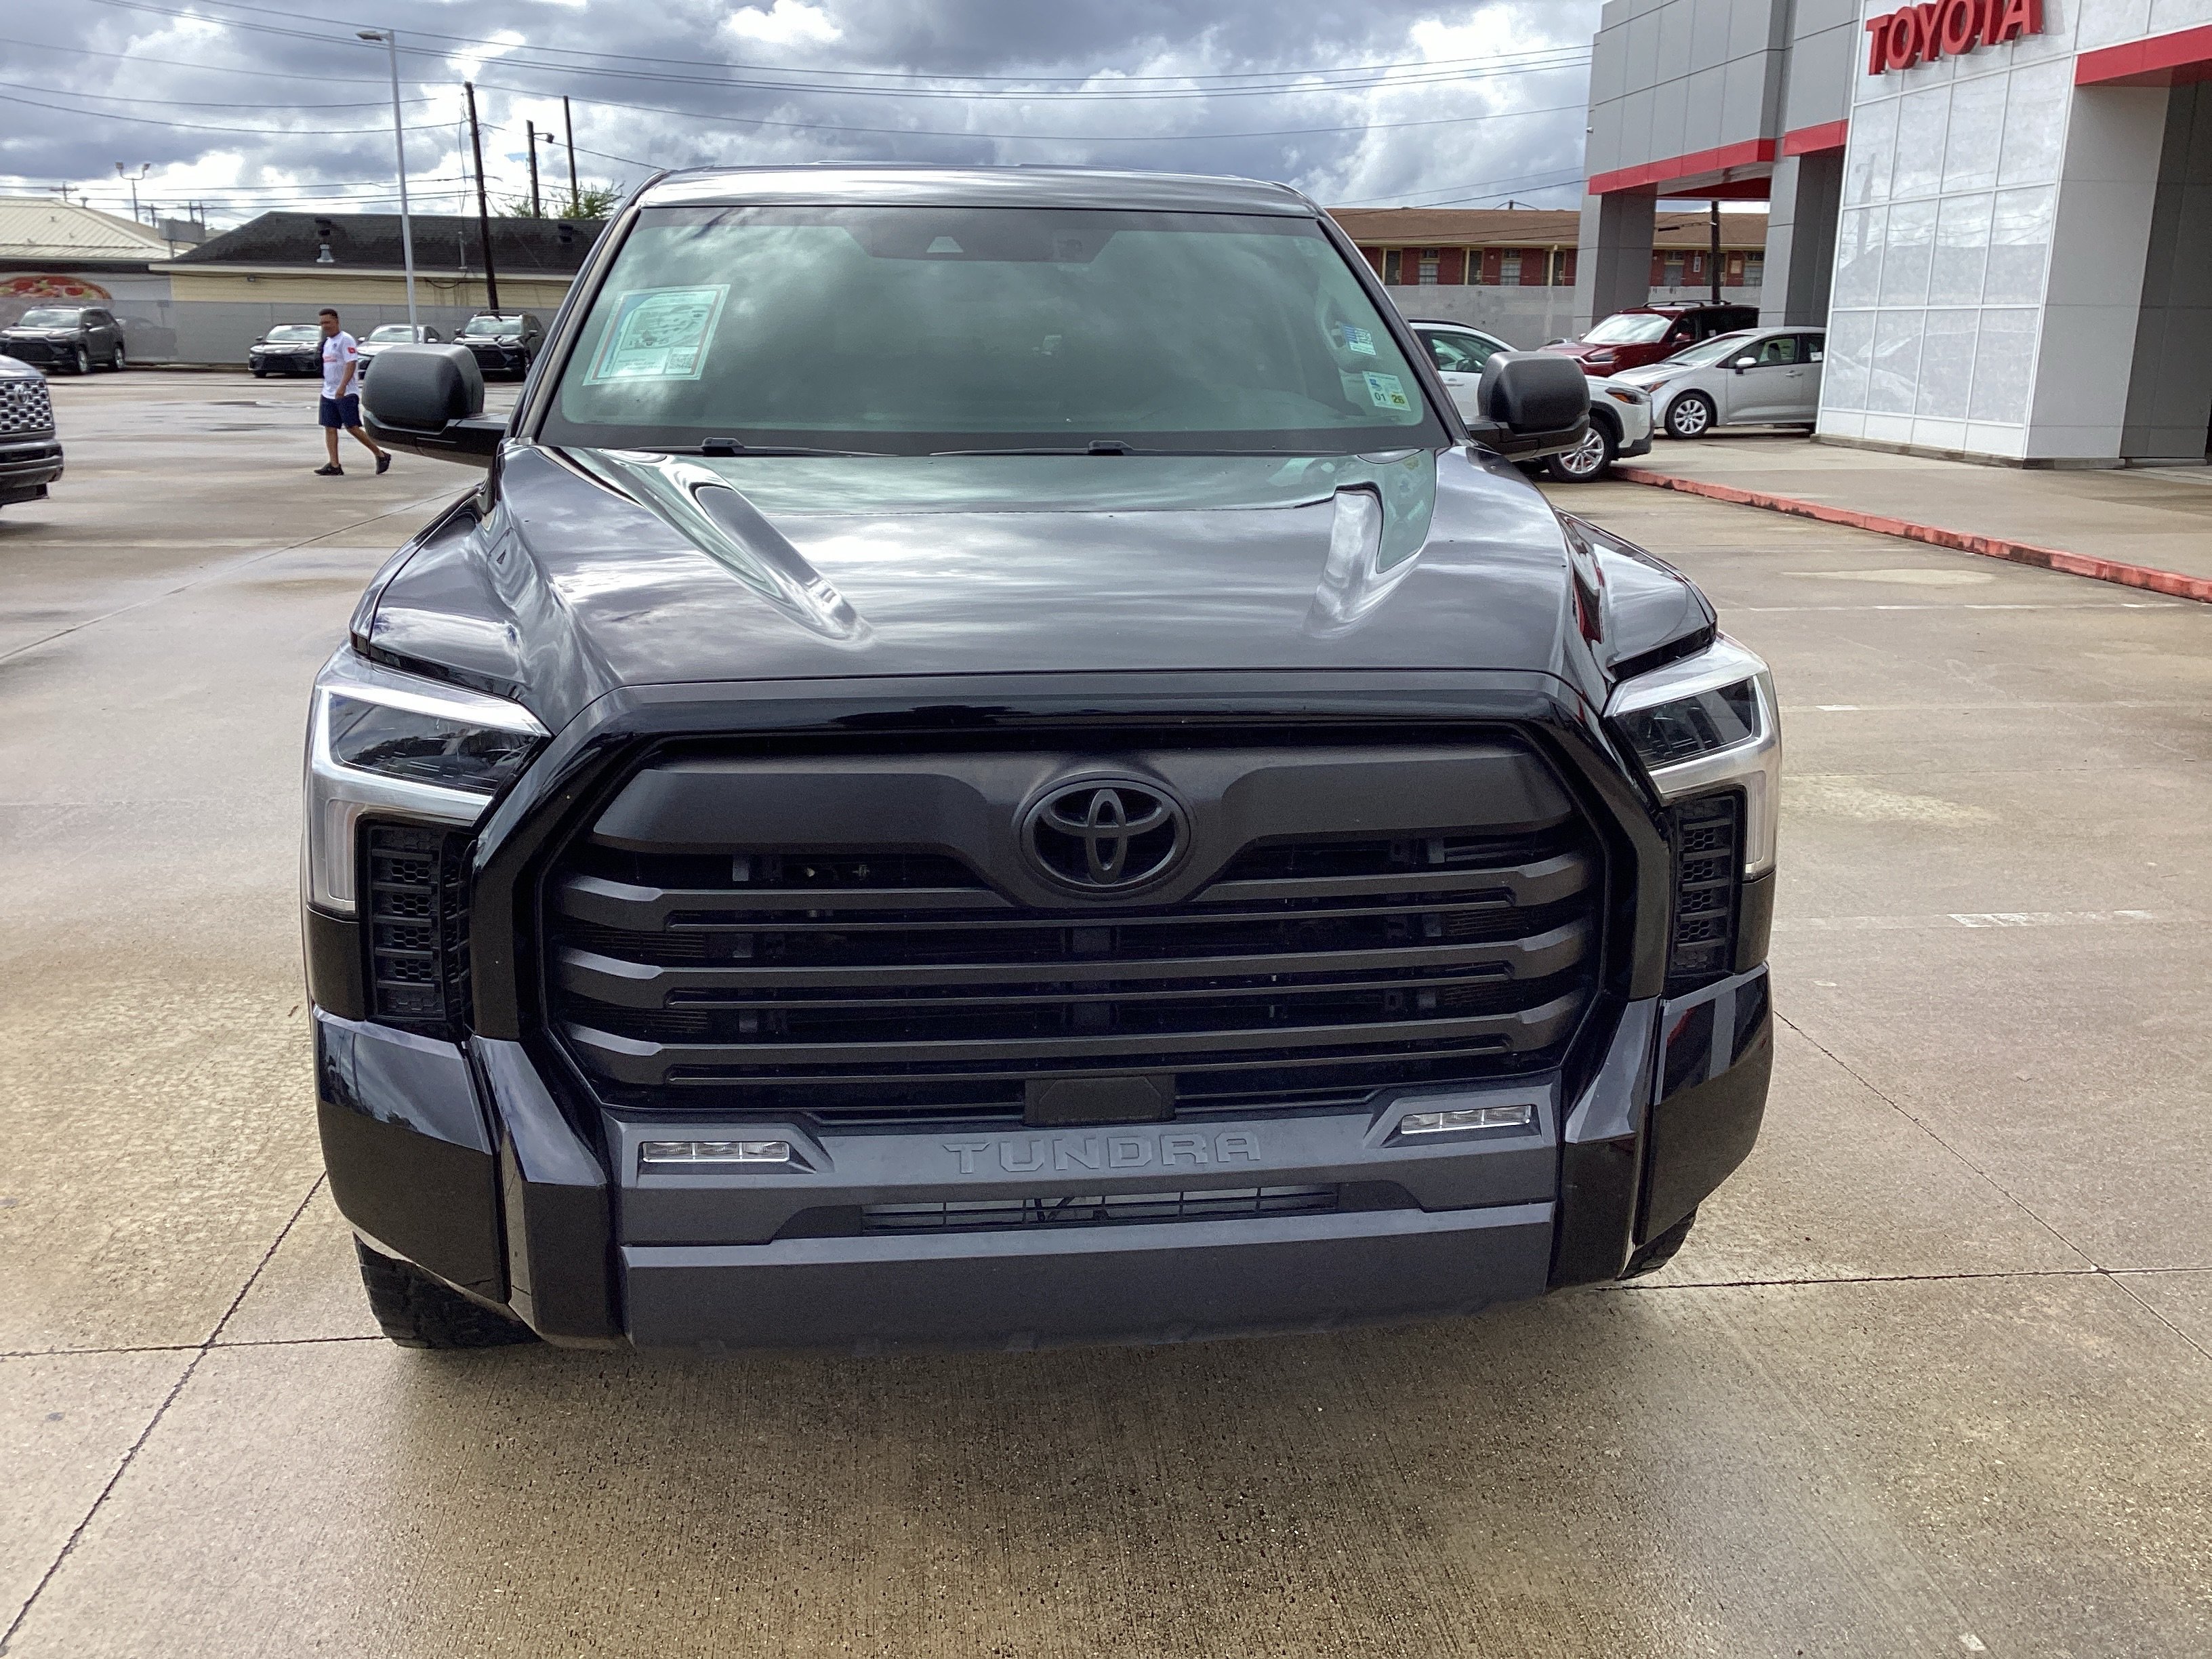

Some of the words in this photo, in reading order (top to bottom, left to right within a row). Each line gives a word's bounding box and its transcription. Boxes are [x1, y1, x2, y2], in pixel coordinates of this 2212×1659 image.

[1866, 0, 2043, 76] TOYOTA
[1374, 392, 1386, 401] 01
[943, 1130, 1261, 1174] TUNDRA
